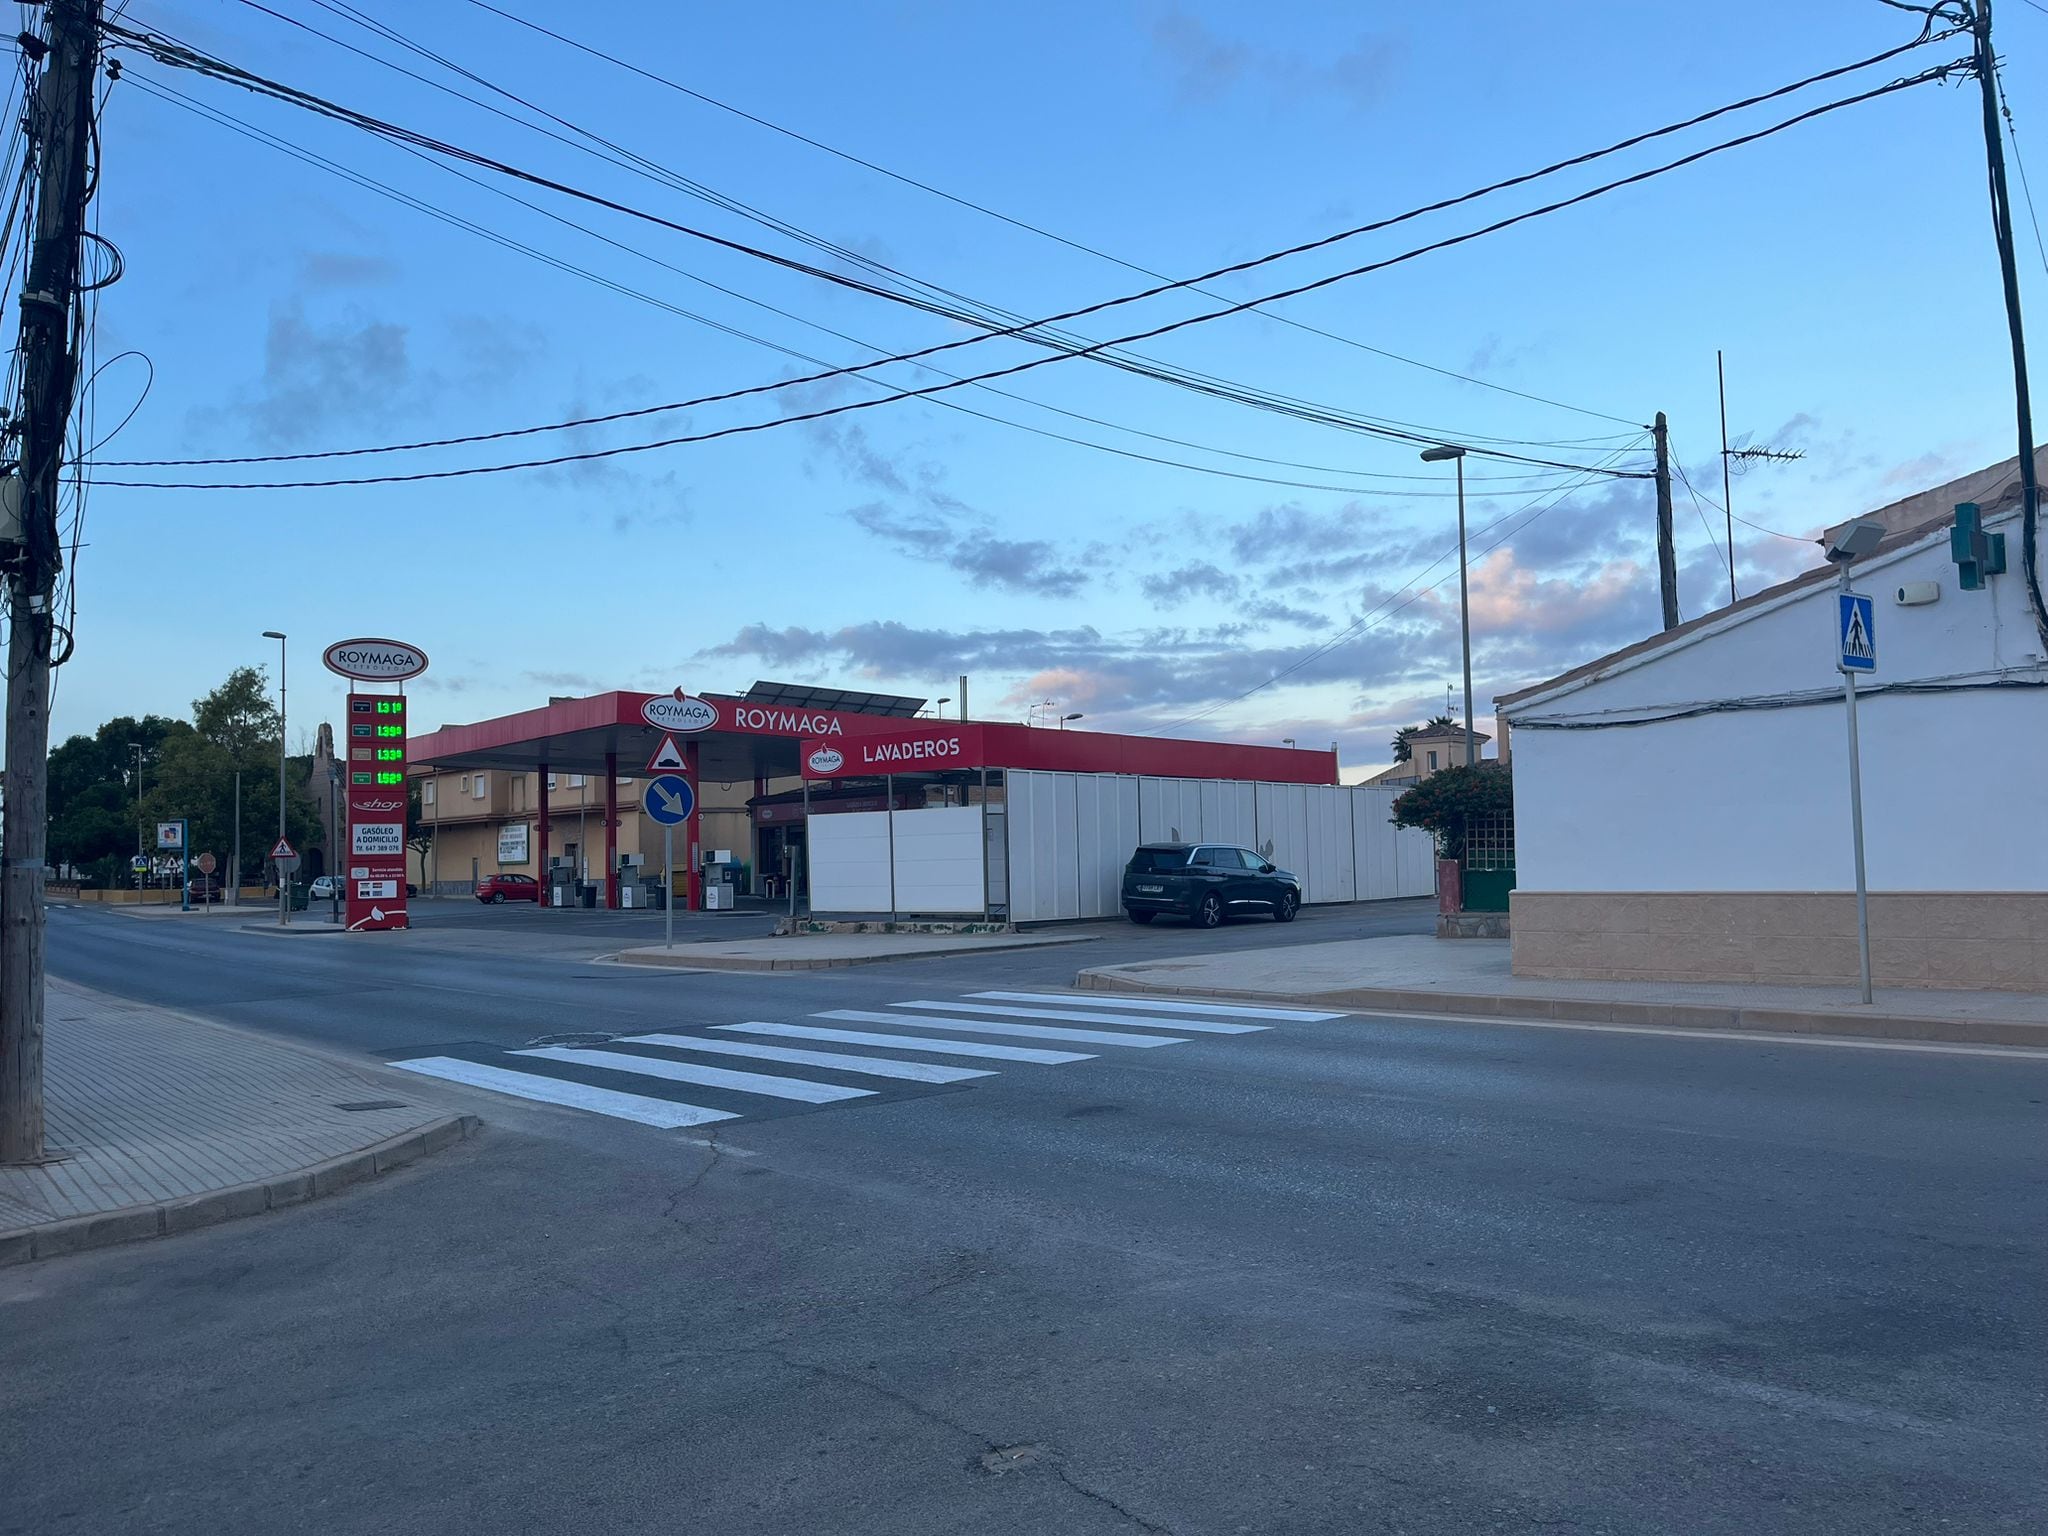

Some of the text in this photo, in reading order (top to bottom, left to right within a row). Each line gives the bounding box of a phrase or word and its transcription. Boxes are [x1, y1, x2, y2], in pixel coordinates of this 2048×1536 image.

[339, 651, 415, 666] ROYMAGA
[649, 704, 710, 719] ROYMAGA
[735, 707, 843, 736] ROYMAGA
[863, 737, 960, 763] LAVADEROS
[812, 755, 841, 765] ROYMAGA
[358, 798, 403, 811] shop
